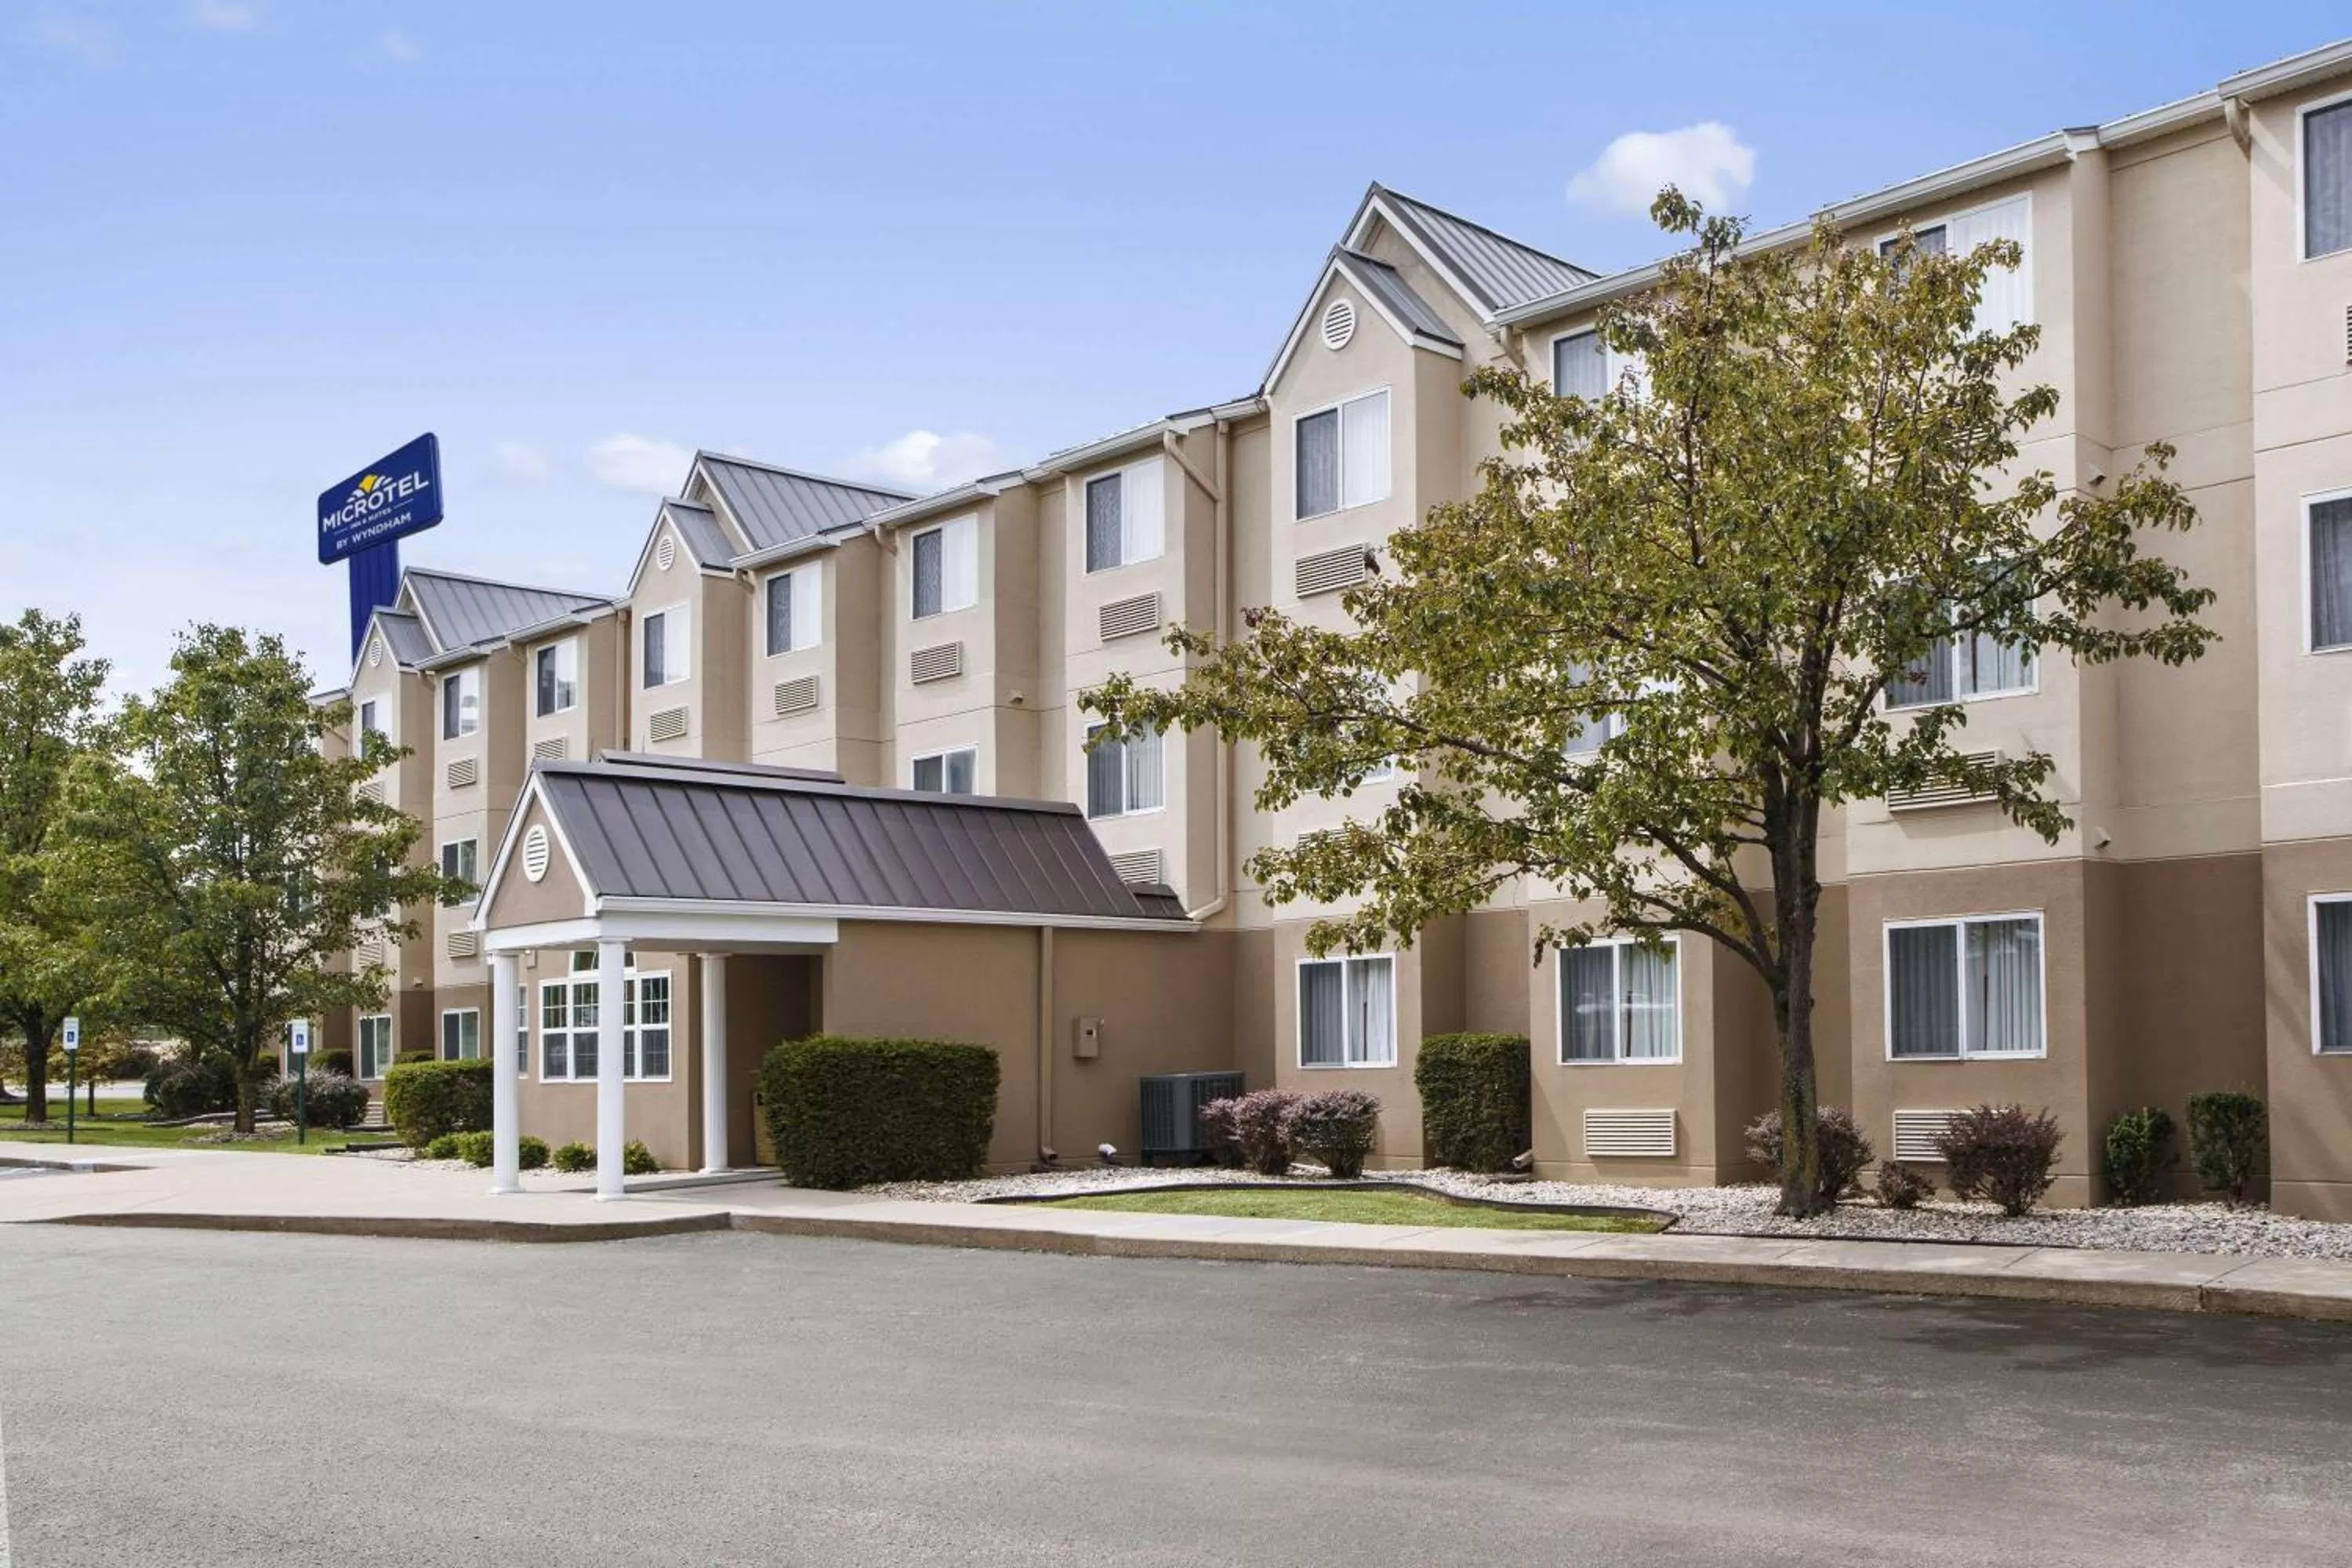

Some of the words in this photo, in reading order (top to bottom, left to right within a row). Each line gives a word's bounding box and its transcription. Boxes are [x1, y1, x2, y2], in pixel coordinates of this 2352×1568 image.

[322, 471, 430, 532] MICROTEL
[336, 537, 348, 550] BY
[352, 512, 412, 543] WYNDHAM
